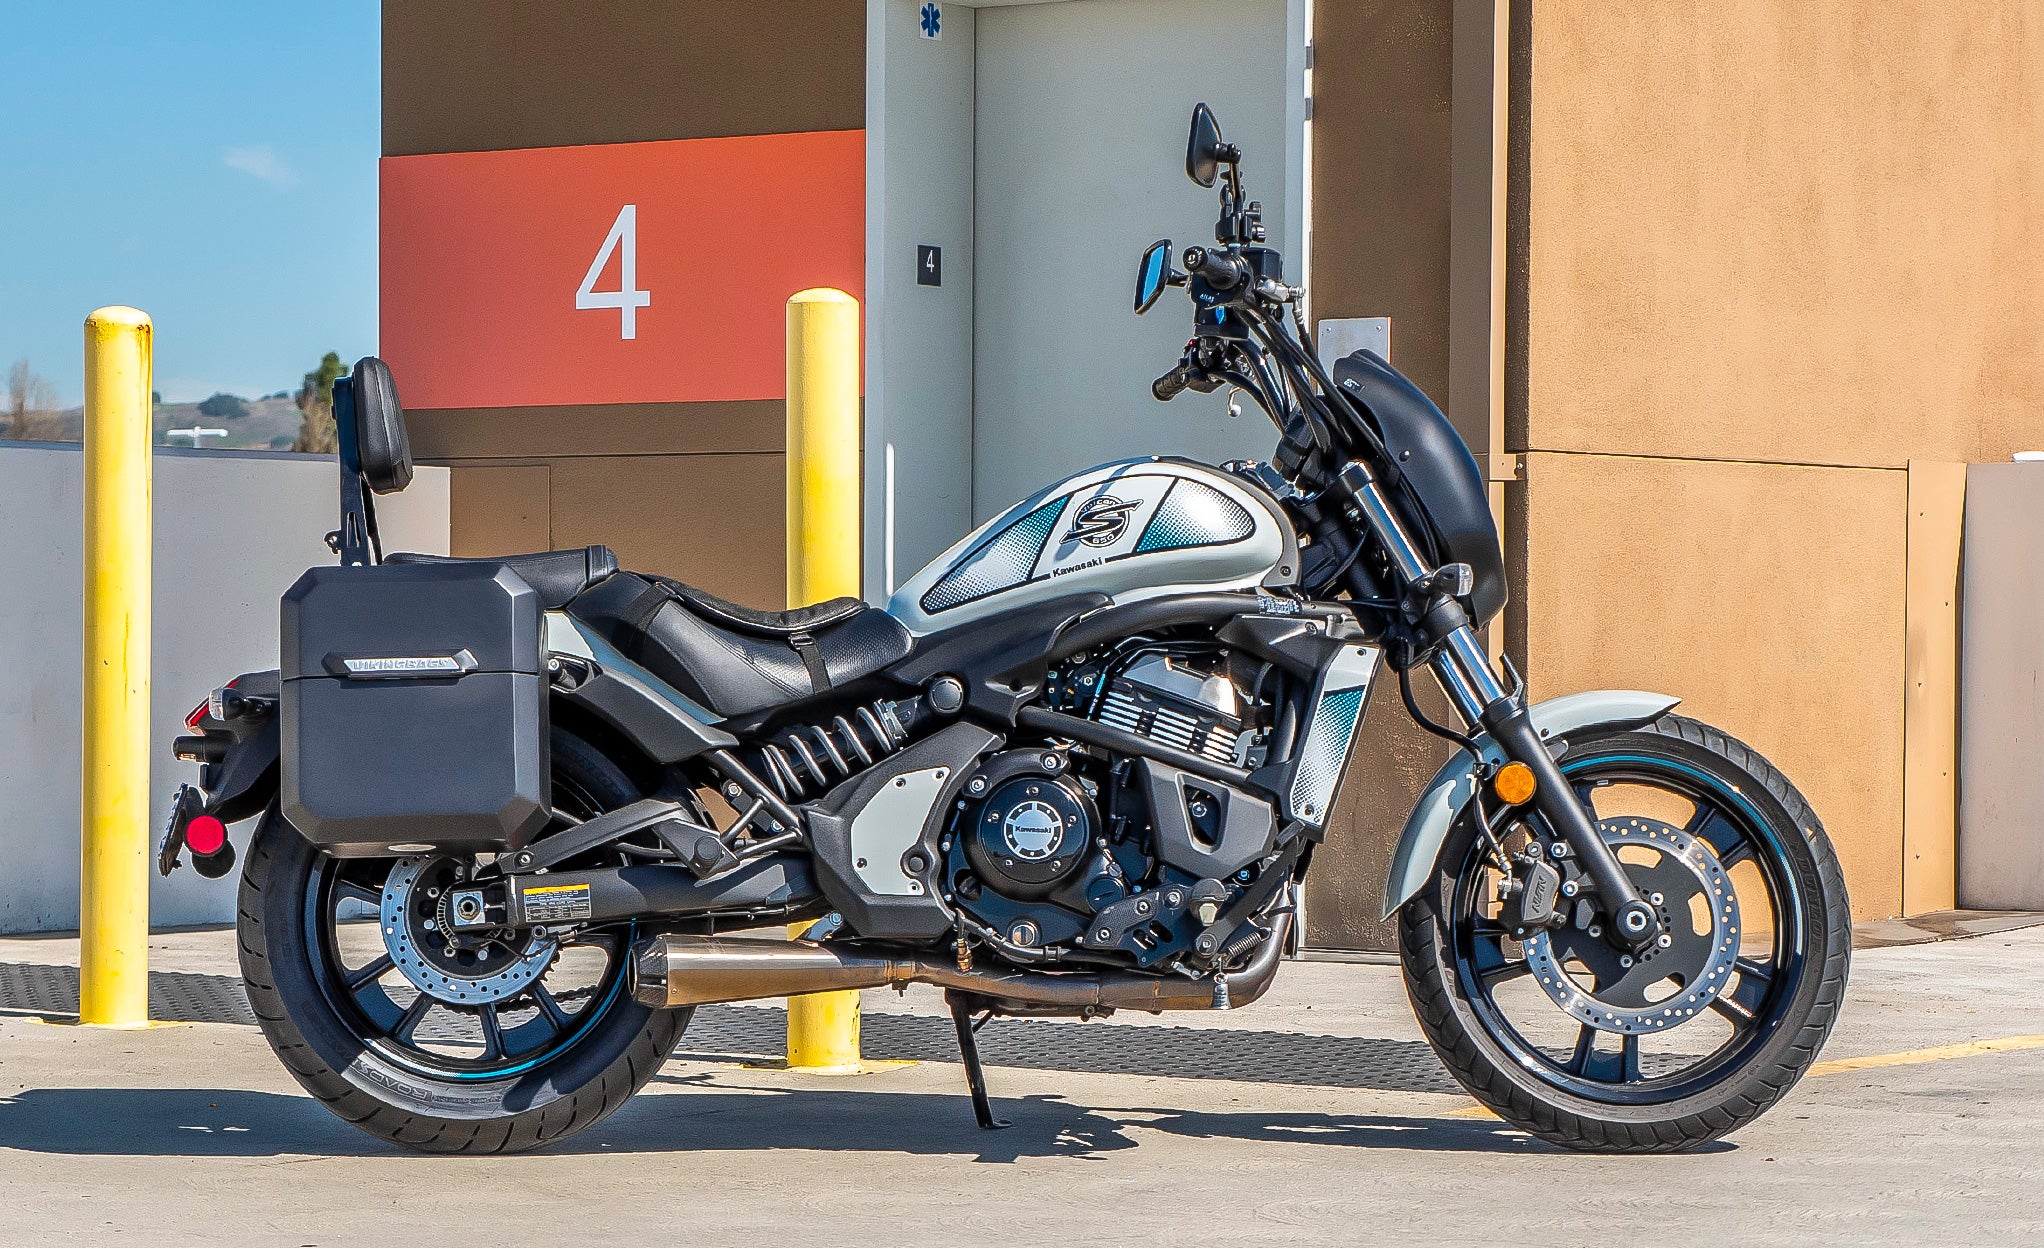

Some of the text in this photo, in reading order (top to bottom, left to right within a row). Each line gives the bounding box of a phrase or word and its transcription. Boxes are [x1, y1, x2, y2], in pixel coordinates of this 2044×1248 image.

[926, 249, 935, 273] 4
[575, 204, 650, 340] 4
[1092, 533, 1115, 544] 650
[1053, 557, 1102, 578] Kawasaki
[1015, 826, 1051, 834] Kawasaki
